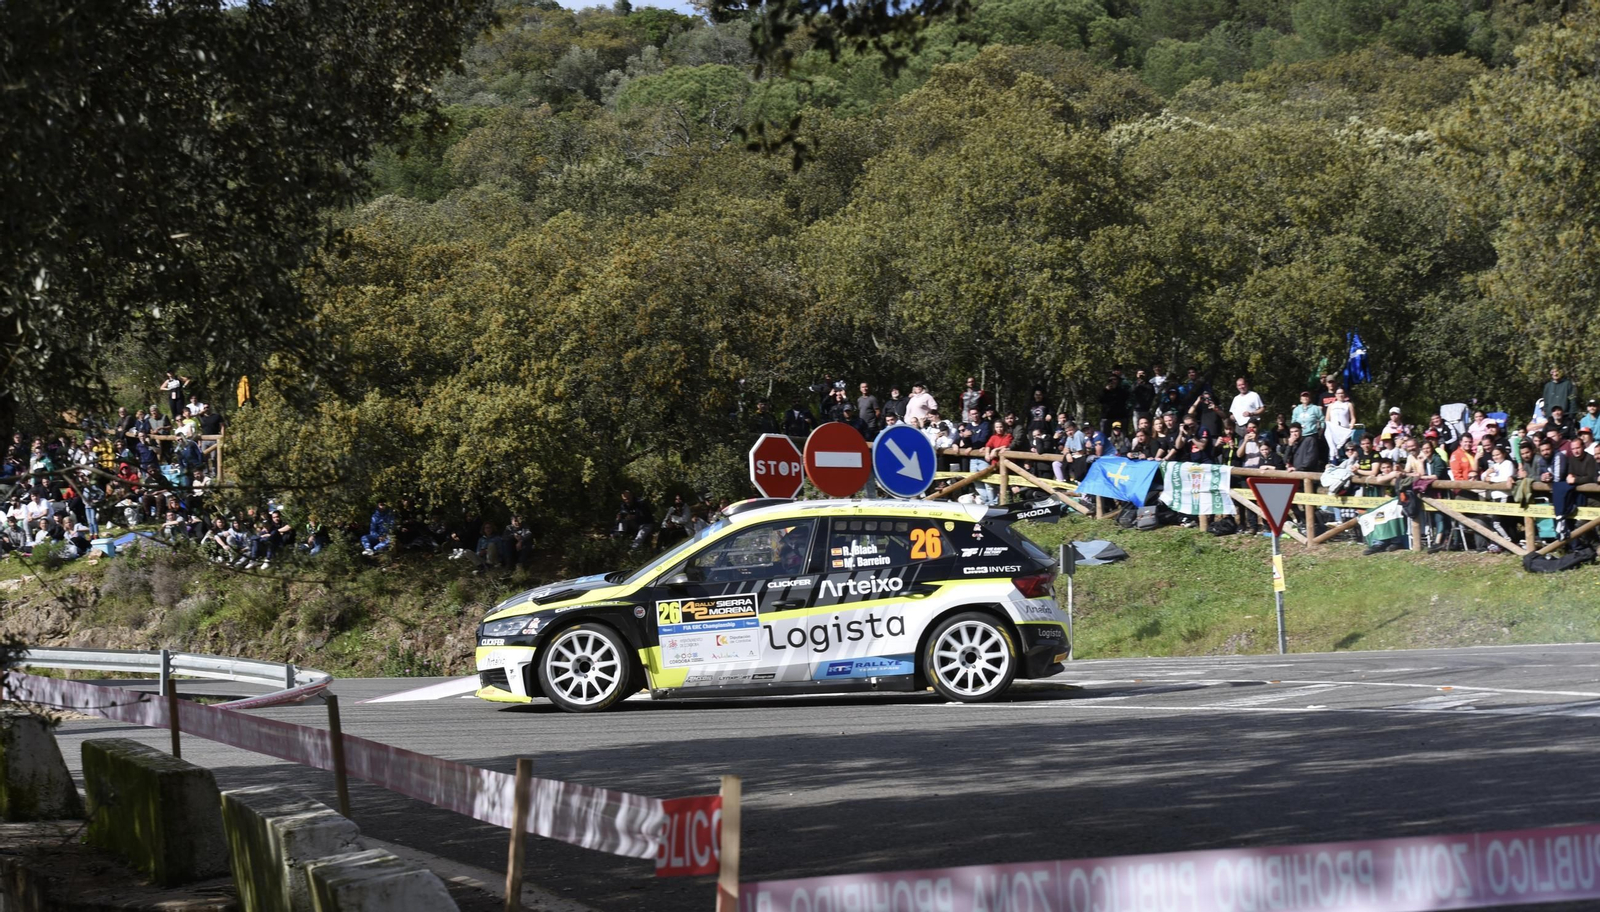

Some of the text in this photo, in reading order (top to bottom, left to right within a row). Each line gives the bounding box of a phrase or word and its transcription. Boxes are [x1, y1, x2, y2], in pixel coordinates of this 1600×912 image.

[756, 460, 800, 476] STOP
[1017, 508, 1051, 519] SKODA
[909, 527, 942, 560] 26
[842, 544, 878, 556] R. Blach
[844, 555, 891, 568] M. Barreiro
[989, 565, 1021, 573] INVEST
[767, 578, 811, 589] CLICKFER
[818, 575, 904, 599] Arteixo
[716, 599, 752, 608] SIERRA
[658, 602, 681, 624] 26
[709, 606, 754, 615] MORENA
[703, 621, 736, 630] Championship
[763, 613, 905, 653] logista
[828, 660, 903, 673] RTS RALLYE
